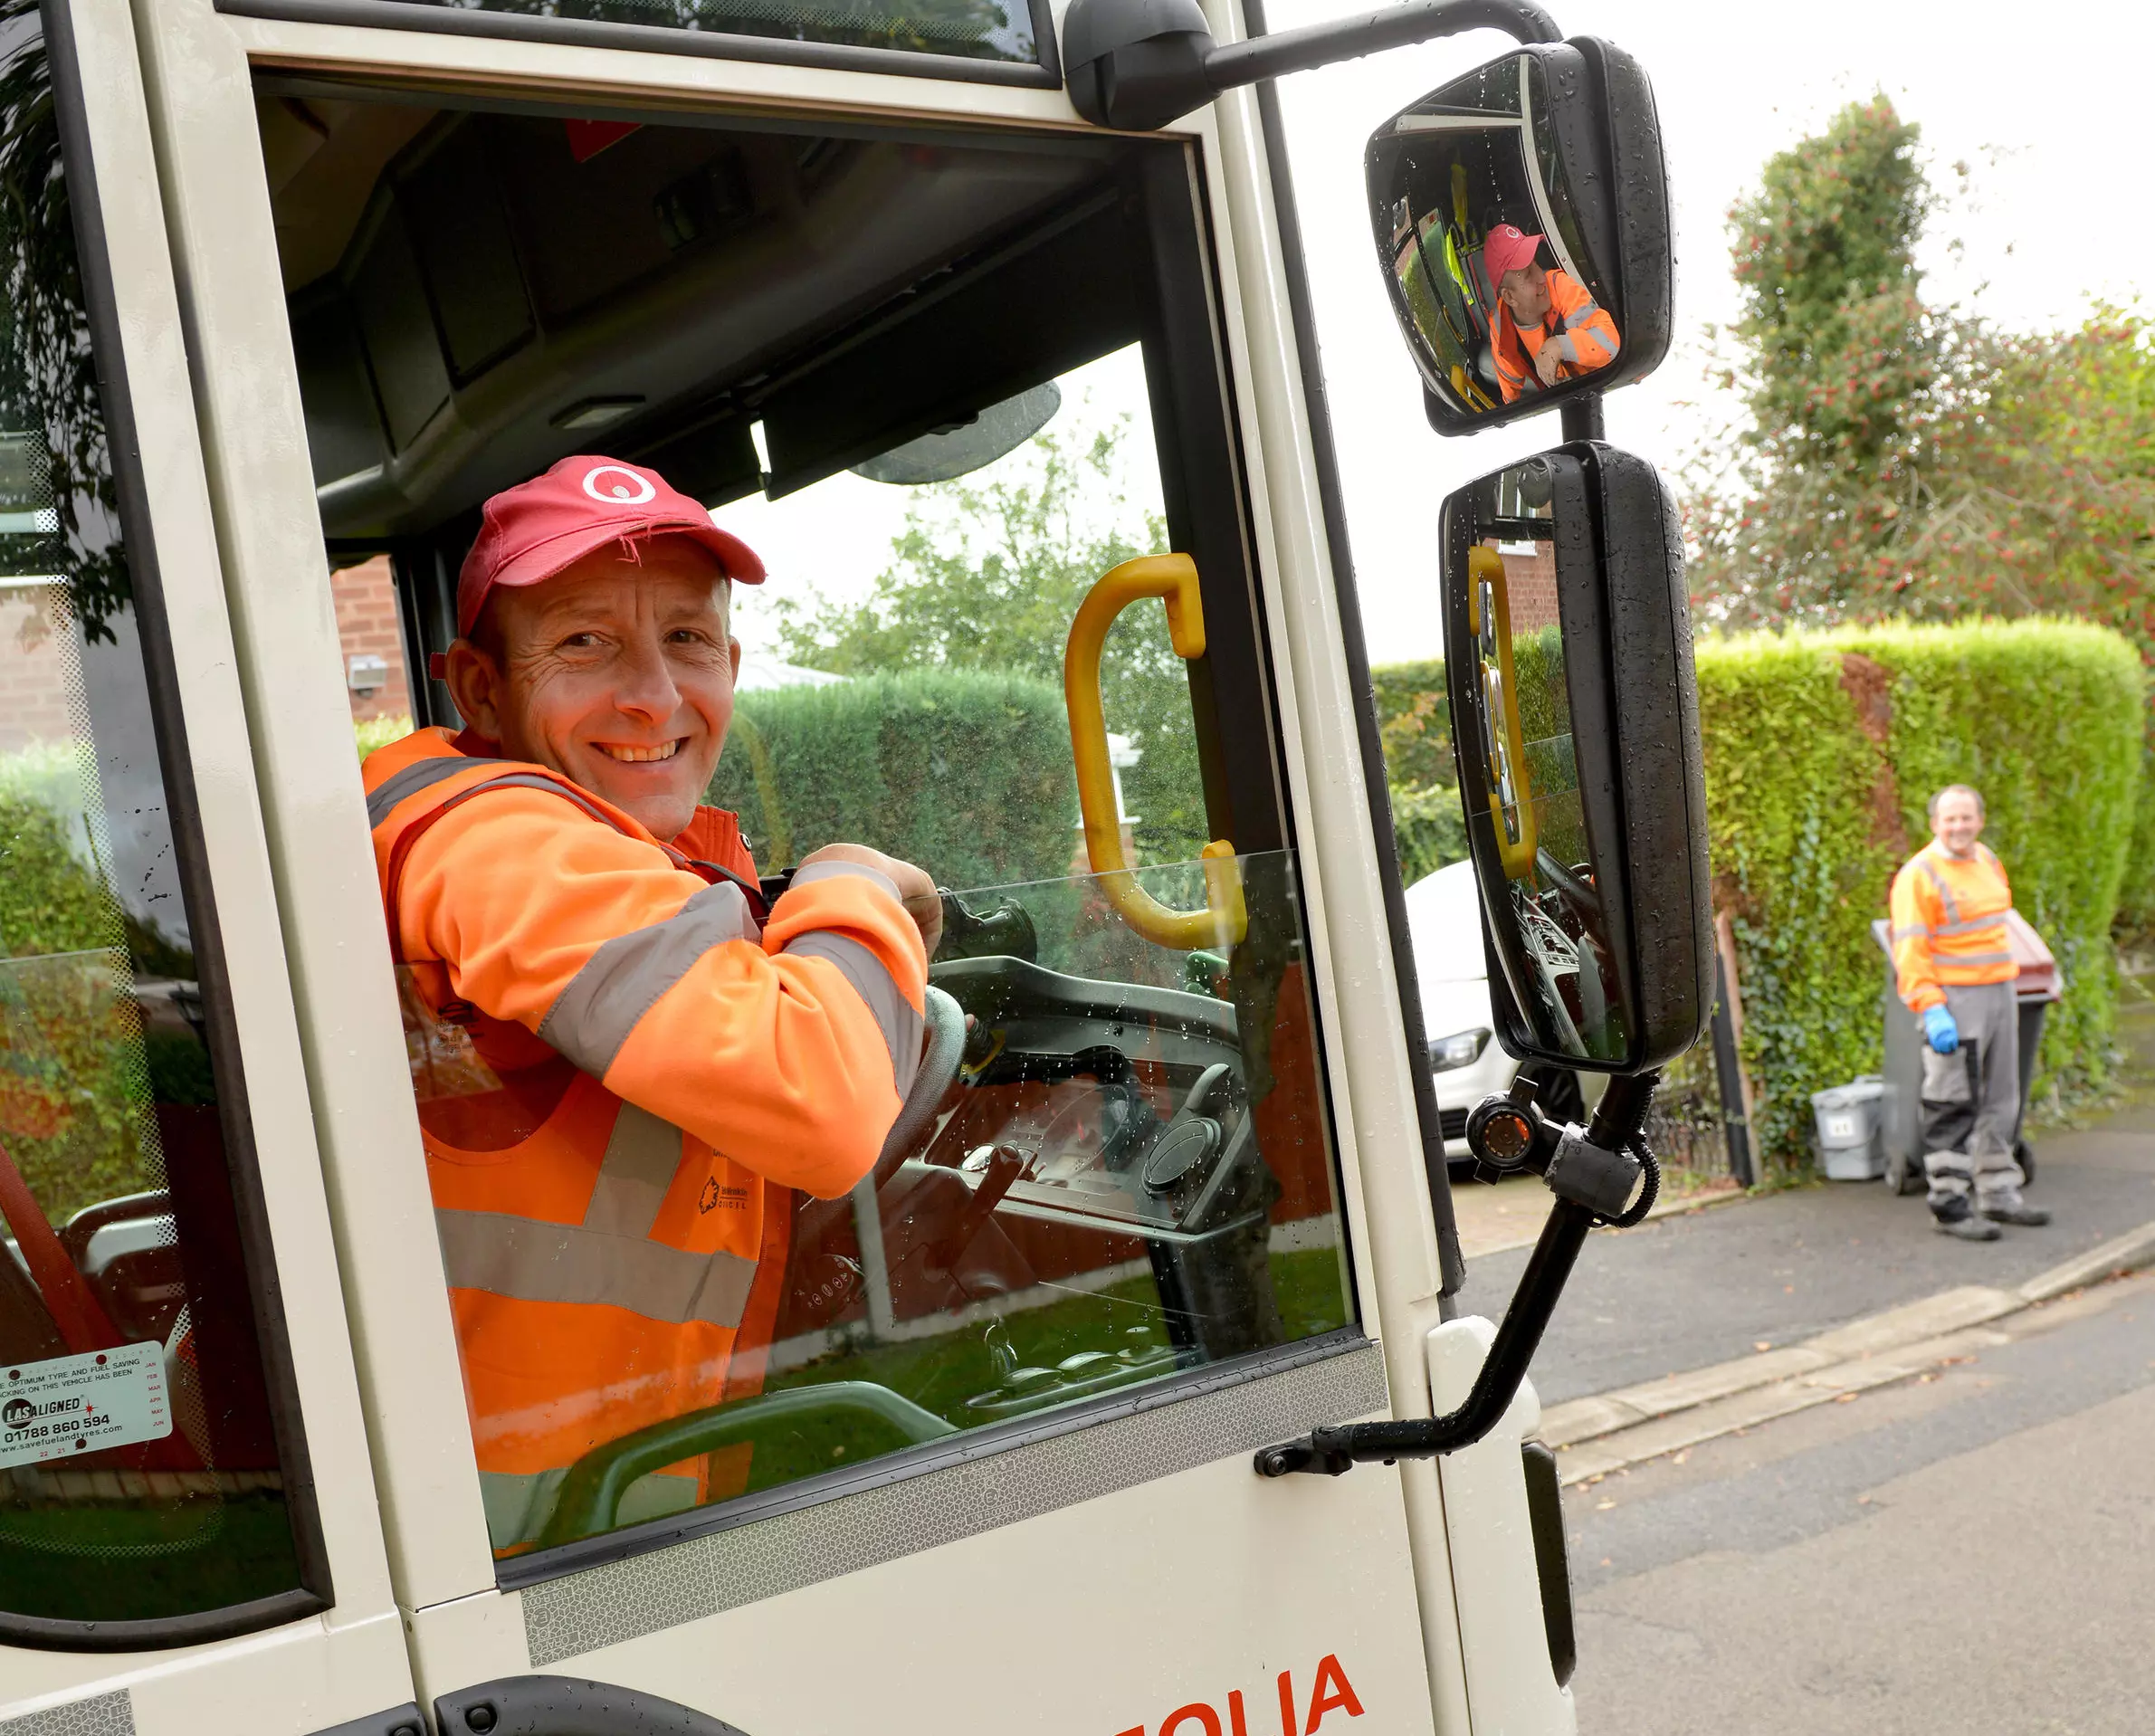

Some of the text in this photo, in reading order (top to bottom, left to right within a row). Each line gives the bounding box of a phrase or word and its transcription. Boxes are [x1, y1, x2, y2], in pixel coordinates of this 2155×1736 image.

[8, 1376, 45, 1388] OPTIMUM
[48, 1371, 69, 1380] TYRE
[72, 1368, 88, 1377] AND
[91, 1364, 110, 1373] FUEL
[112, 1359, 140, 1369] SAVING
[43, 1383, 59, 1391] THIS
[62, 1377, 92, 1388] VEHICLE
[95, 1373, 110, 1381] HAS
[112, 1369, 133, 1378] BEEN
[5, 1414, 110, 1444] 01788 860 594
